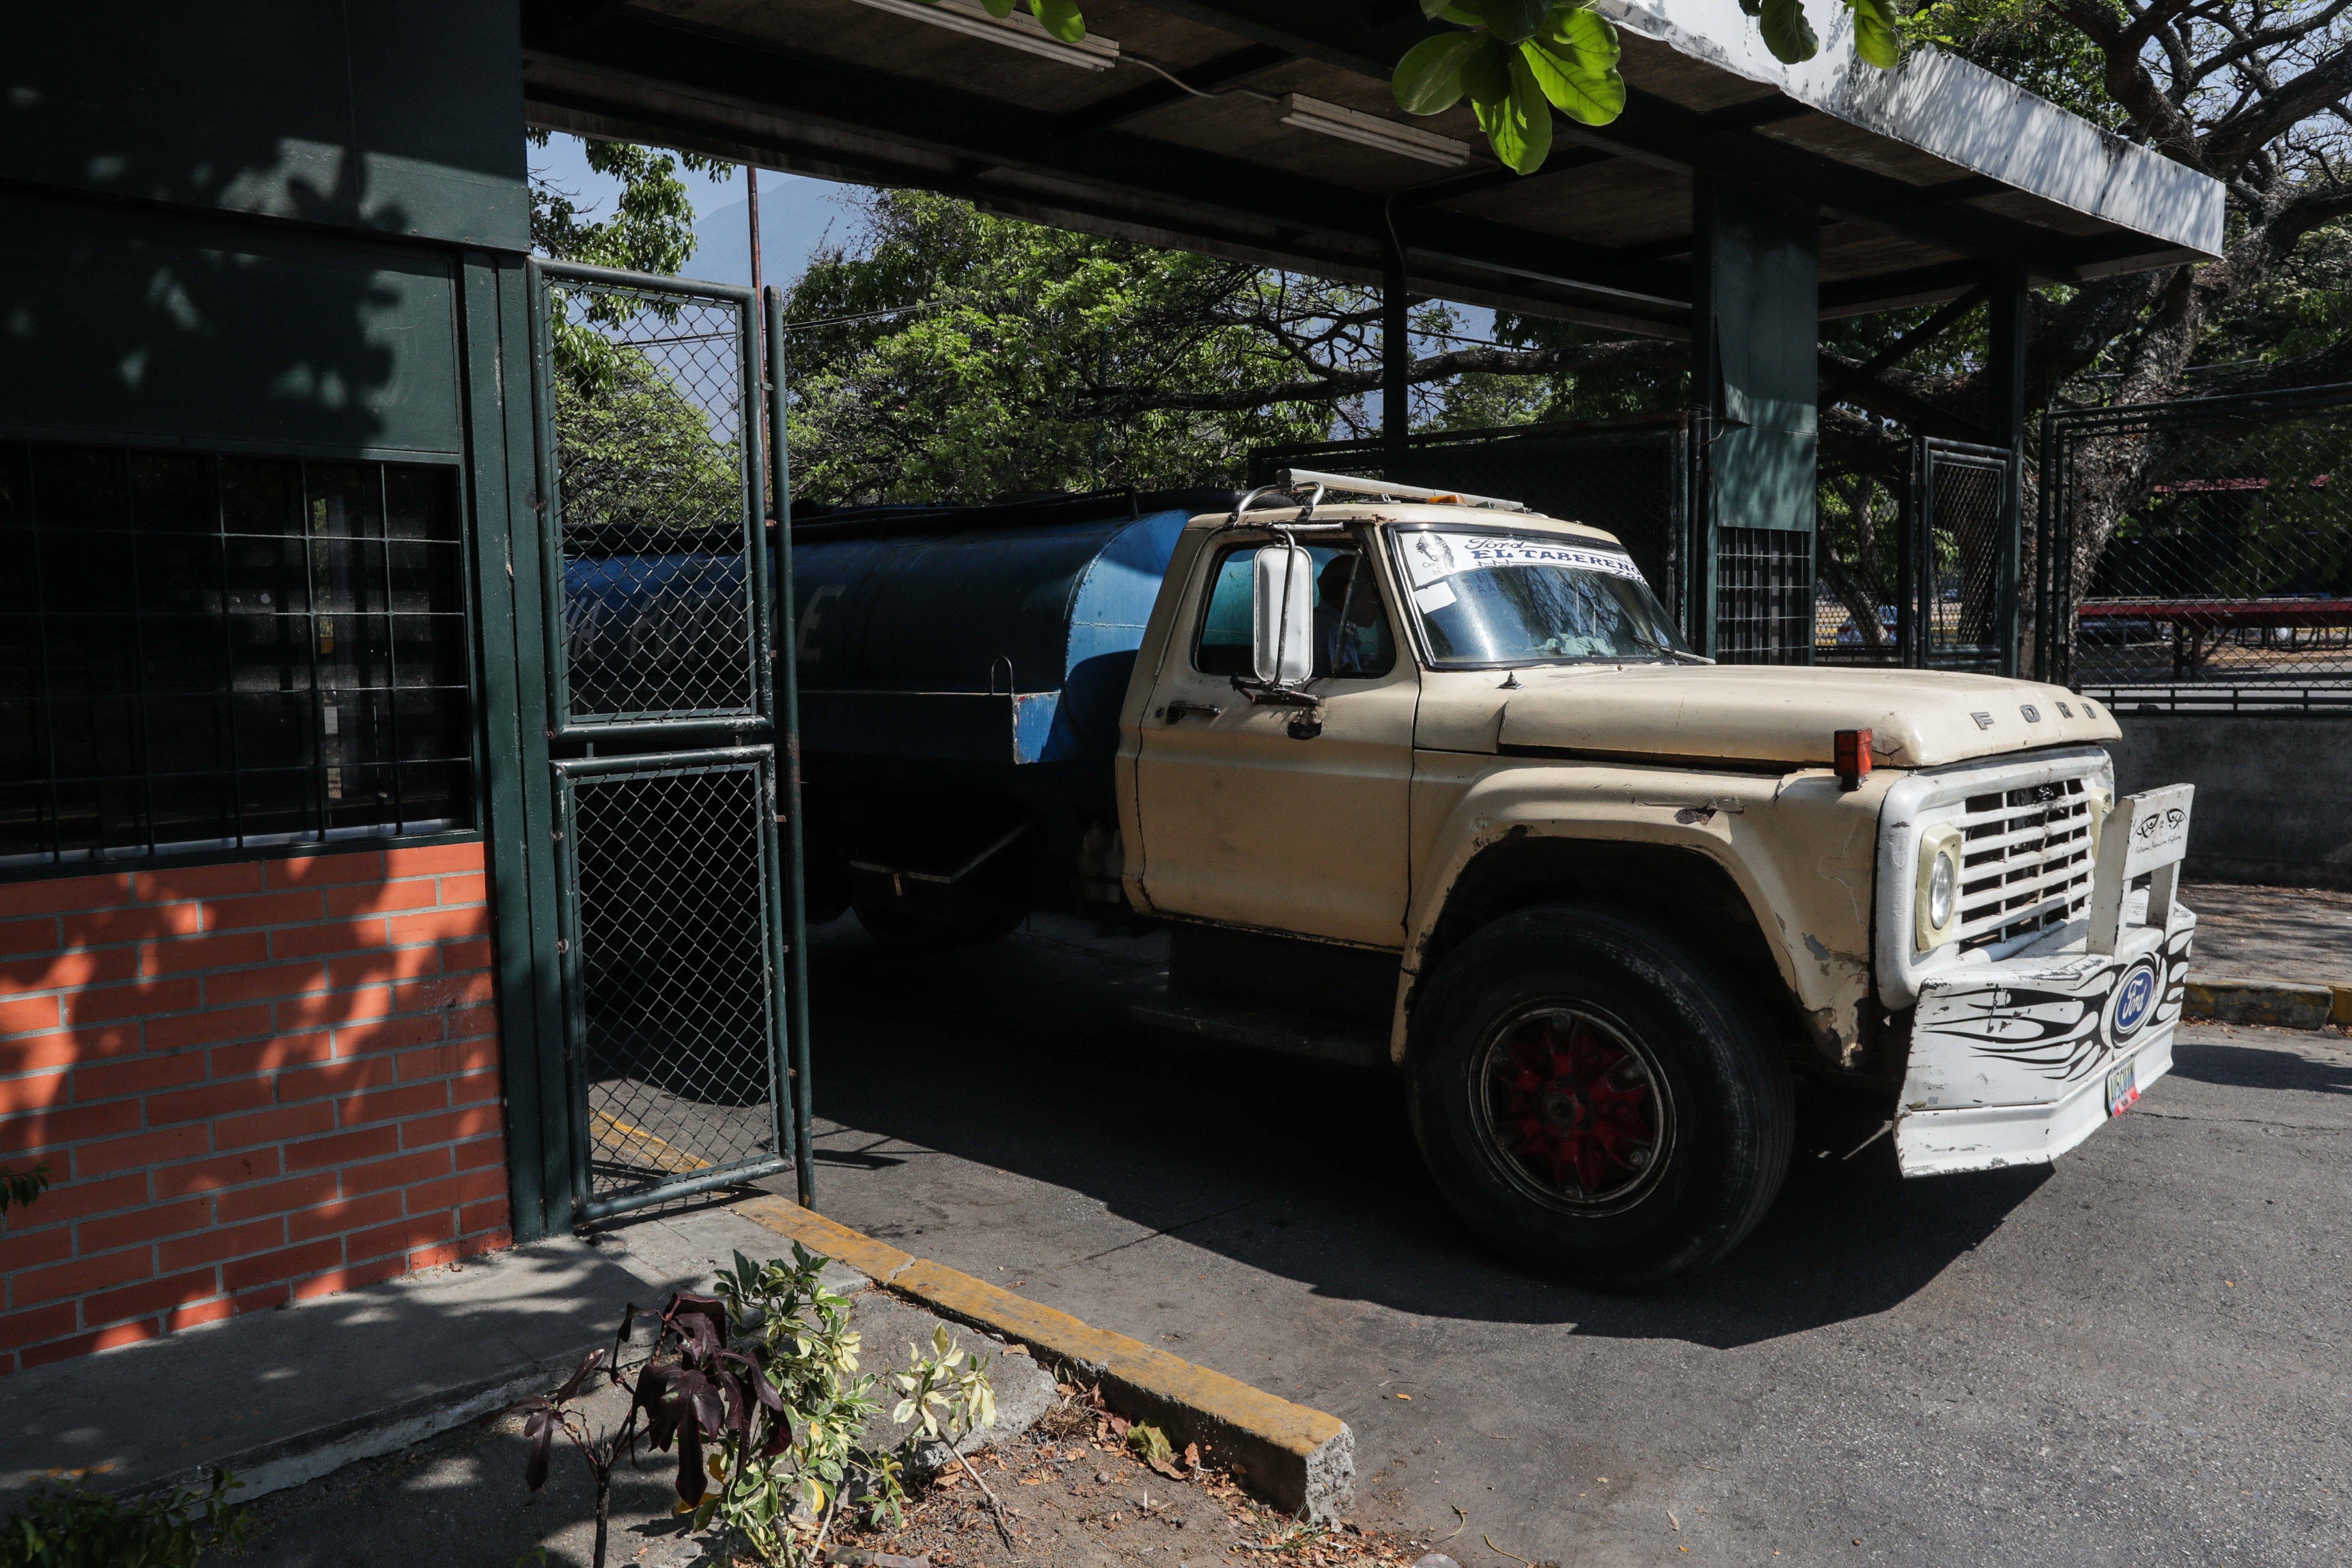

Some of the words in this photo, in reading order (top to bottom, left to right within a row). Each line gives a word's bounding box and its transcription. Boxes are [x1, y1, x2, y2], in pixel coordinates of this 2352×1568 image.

[1464, 537, 1525, 549] Ford
[1471, 550, 1513, 559] EL
[1613, 569, 1645, 582] 750
[1971, 701, 2097, 730] FORD
[2121, 978, 2147, 1019] Ford
